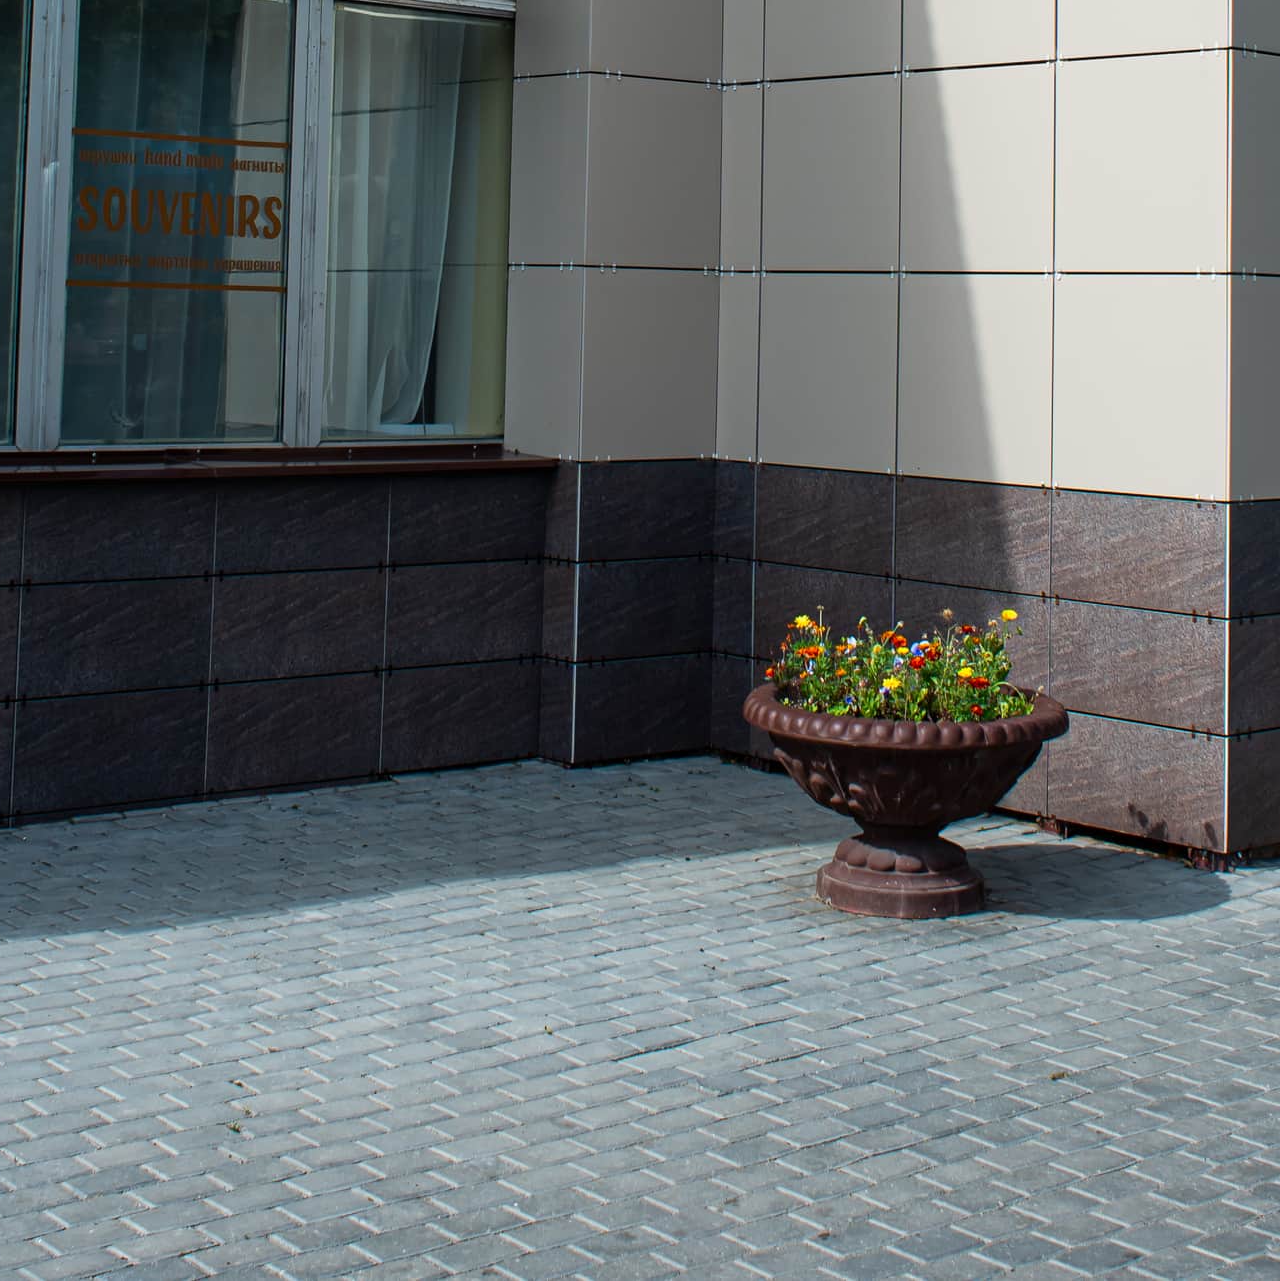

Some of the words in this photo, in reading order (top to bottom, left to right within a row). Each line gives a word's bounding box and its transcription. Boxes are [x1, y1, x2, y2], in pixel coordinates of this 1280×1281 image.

[144, 145, 181, 167] hand
[231, 158, 285, 174] магниты
[77, 184, 283, 239] SOUVENIRS
